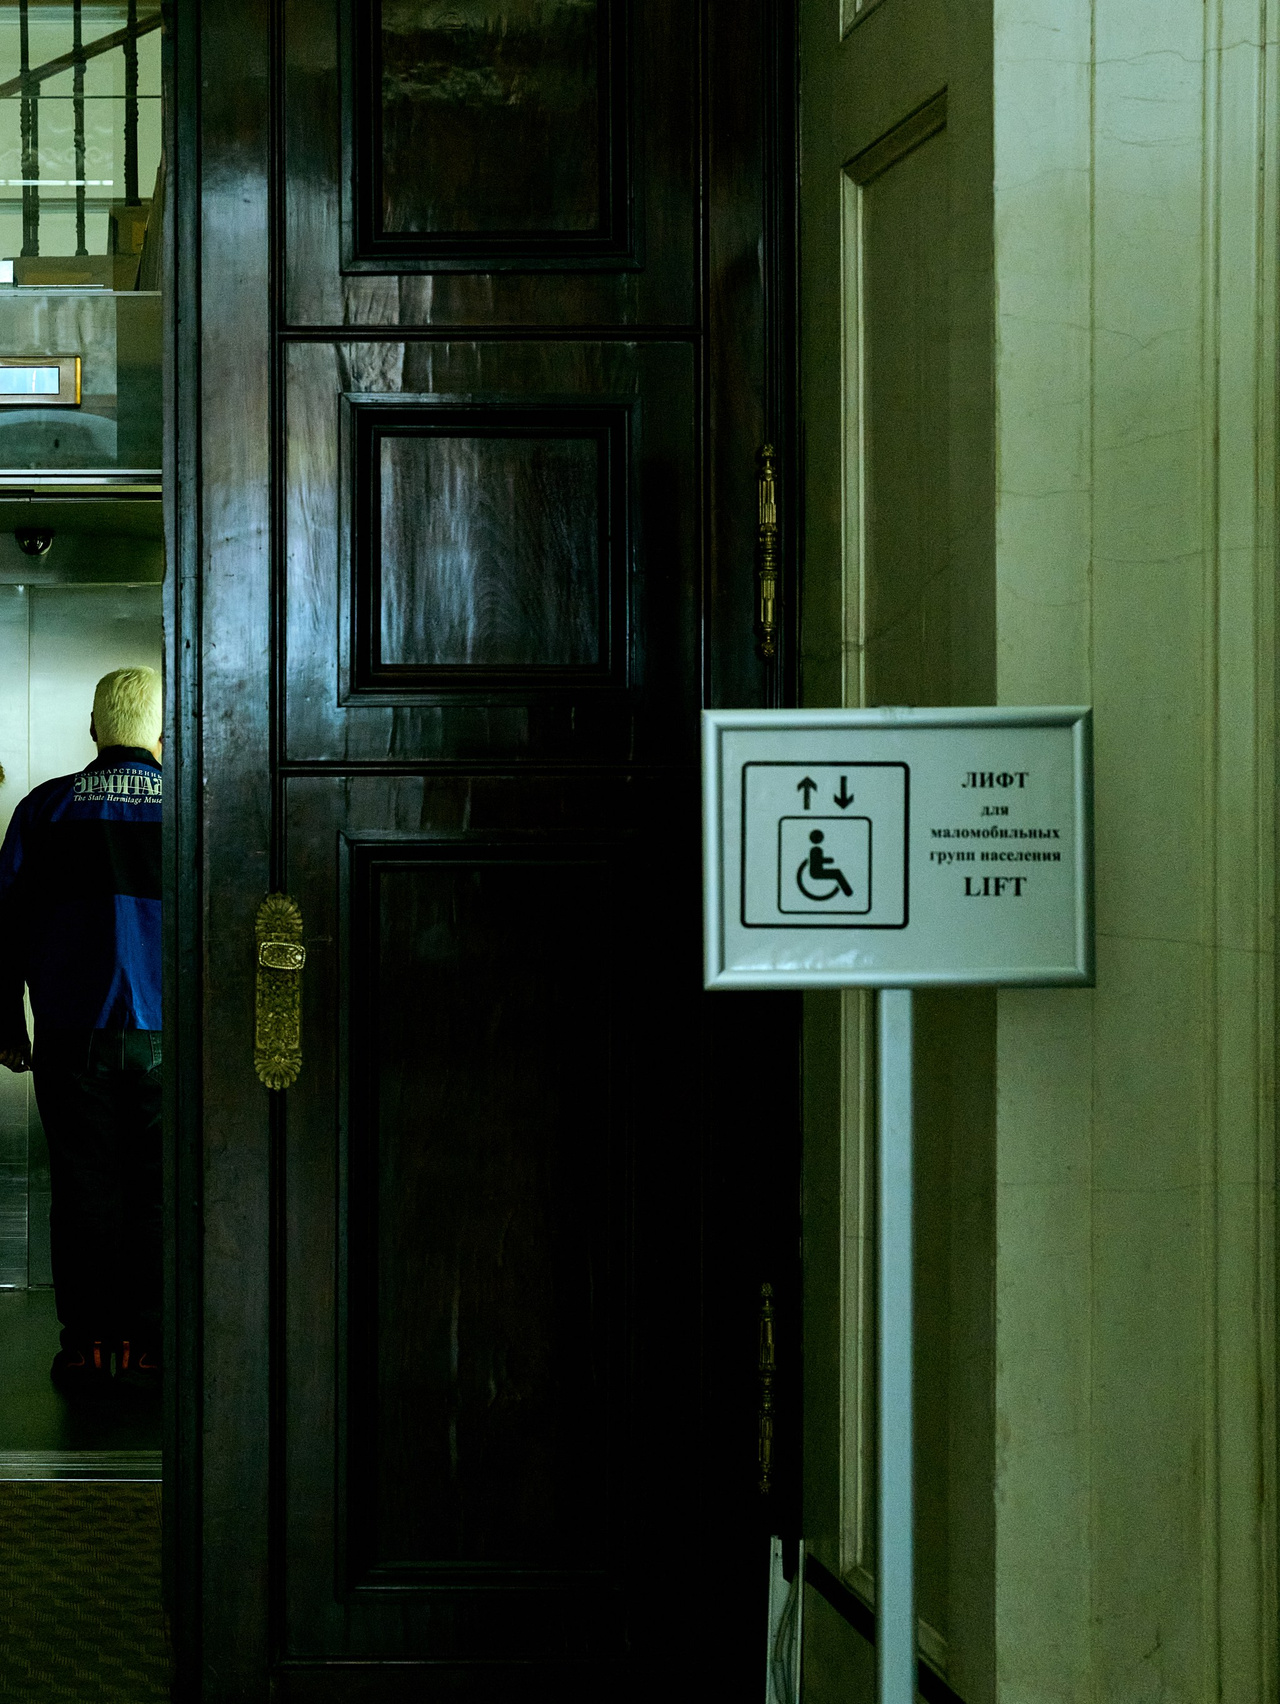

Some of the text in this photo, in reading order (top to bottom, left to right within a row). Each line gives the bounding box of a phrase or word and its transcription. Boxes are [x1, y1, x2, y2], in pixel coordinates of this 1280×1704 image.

[961, 772, 1029, 788] ЛИФТ
[73, 794, 86, 802] The
[88, 793, 105, 801] State
[106, 794, 142, 806] Hermitage
[980, 805, 1009, 817] для
[930, 825, 1060, 839] маломобильных
[929, 851, 1061, 865] групп населения
[964, 876, 1027, 896] LIFT
